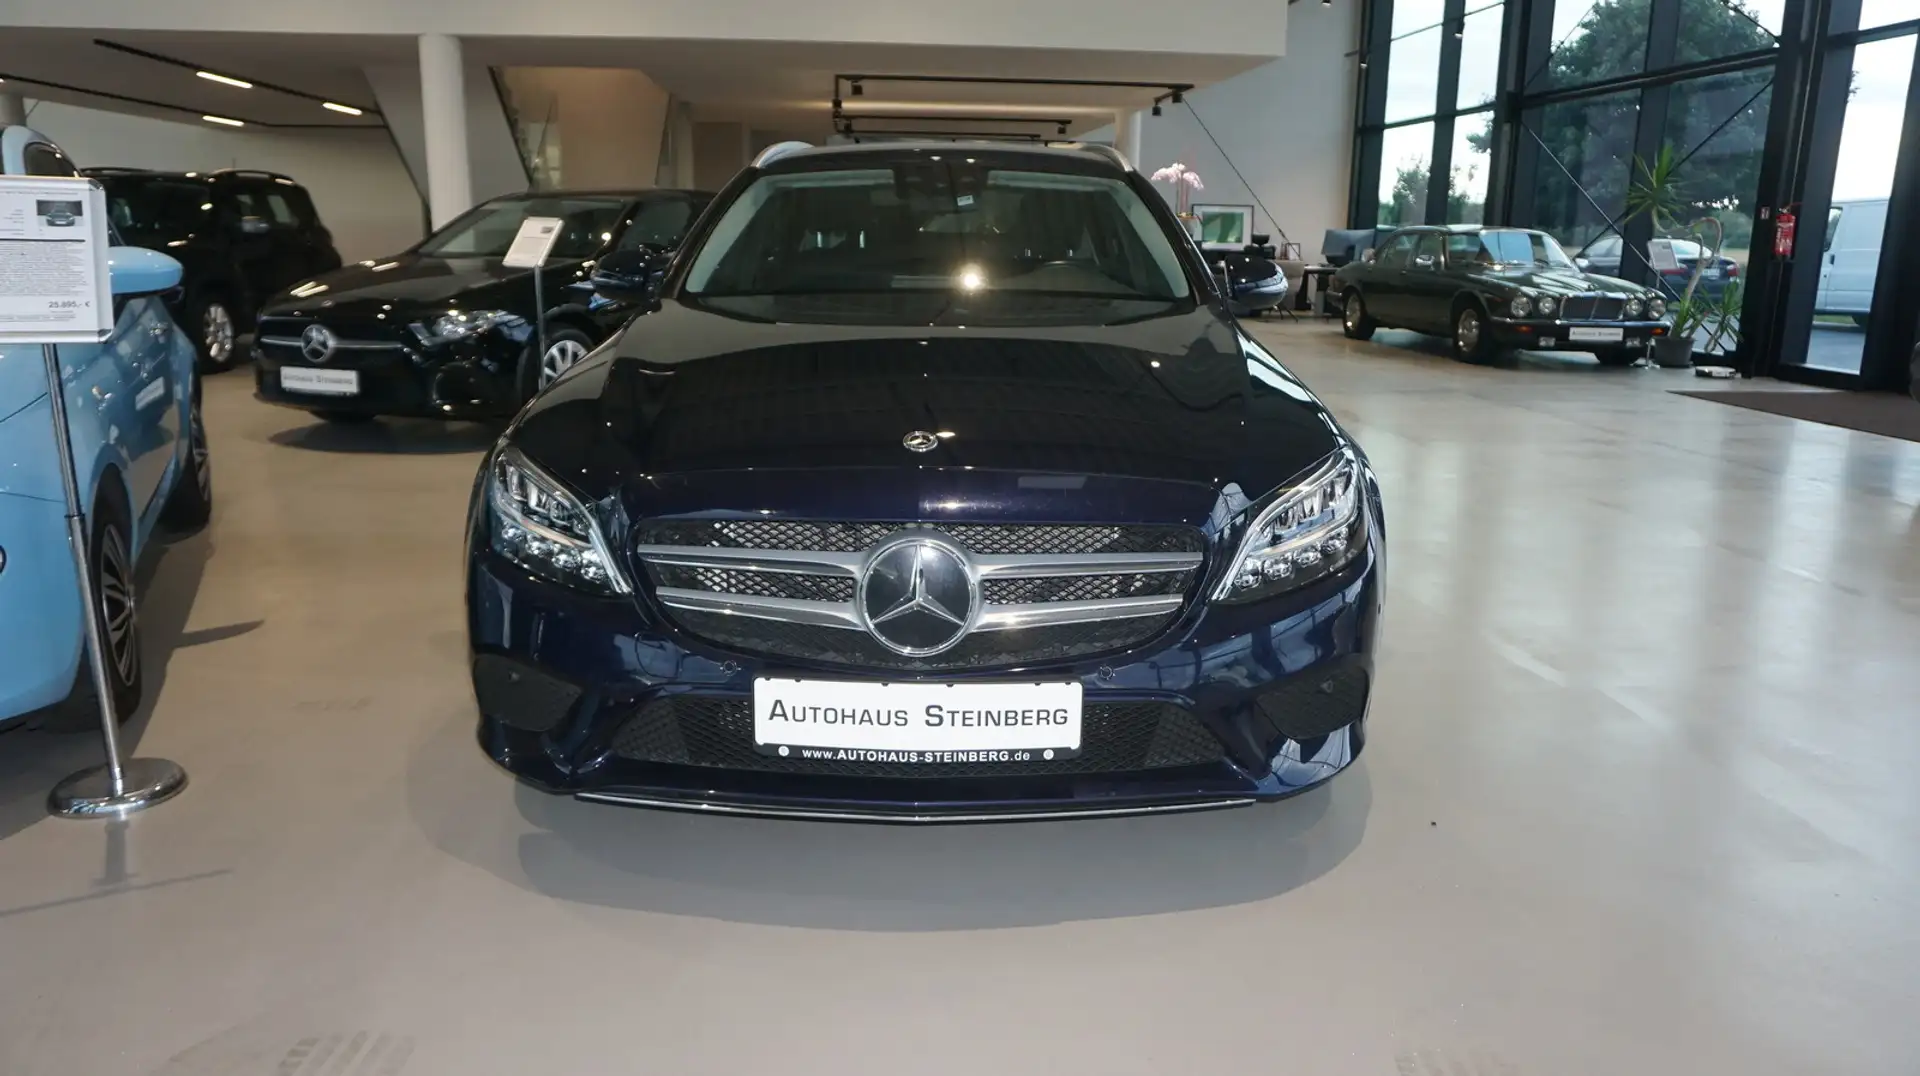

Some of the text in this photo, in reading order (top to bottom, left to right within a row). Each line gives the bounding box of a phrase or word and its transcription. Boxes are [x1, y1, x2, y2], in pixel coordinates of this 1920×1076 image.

[768, 699, 1068, 727] AUTOHAUS STEINBERG
[802, 749, 1031, 763] www.AUTOHAUS-STEINBERG.de
